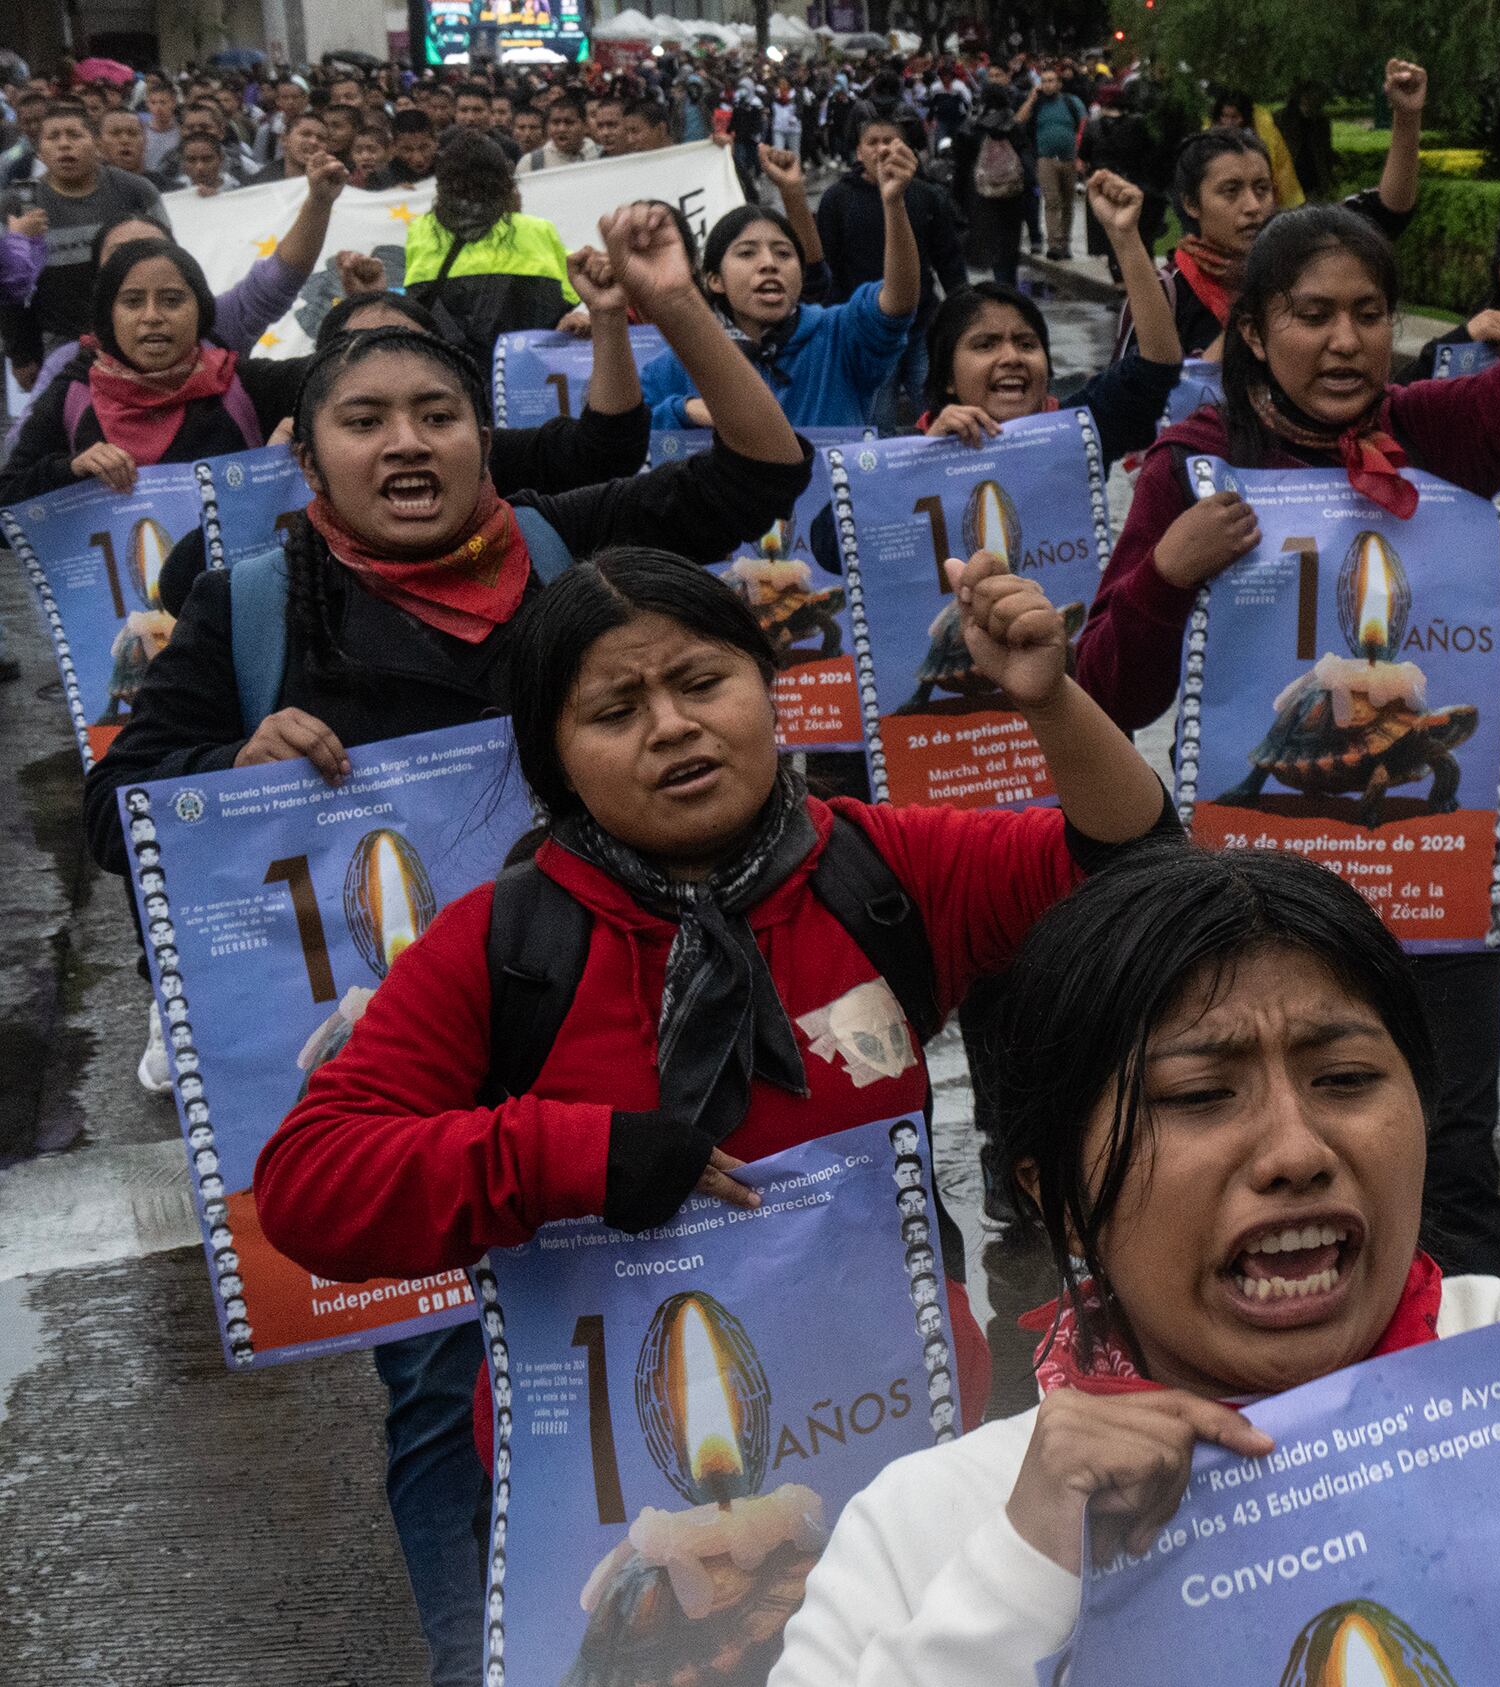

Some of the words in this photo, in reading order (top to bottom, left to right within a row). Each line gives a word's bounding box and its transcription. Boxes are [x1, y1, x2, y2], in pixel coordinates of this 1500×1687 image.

[1323, 508, 1382, 520] Convocan
[1021, 538, 1089, 571] AÑOS
[1403, 618, 1493, 652] AÑOS
[799, 672, 816, 685] de
[818, 671, 852, 684] 2024
[788, 720, 799, 732] al
[804, 718, 843, 731] Zócalo
[809, 704, 824, 716] de
[907, 735, 928, 749] 26
[932, 730, 951, 745] de
[972, 741, 1007, 757] 16:00
[219, 788, 260, 802] Escuela
[261, 781, 300, 795] Normal
[353, 766, 379, 778] Isidro
[416, 752, 428, 765] de
[928, 764, 980, 782] Marcha
[986, 757, 1007, 773] del
[1013, 752, 1047, 769] Ánge
[222, 804, 261, 818] Madres
[263, 803, 270, 813] y
[272, 796, 307, 810] Padres
[308, 791, 321, 802] de
[322, 789, 335, 801] los
[337, 785, 349, 796] 43
[352, 776, 404, 794] Estudiantes
[928, 774, 1028, 799] Independencia
[1034, 769, 1047, 783] al
[995, 787, 1034, 803] CDMX
[317, 801, 393, 826] Convocan
[1223, 832, 1249, 849] 26
[1254, 832, 1277, 849] de
[1284, 834, 1386, 857] septiembre
[1392, 834, 1414, 851] de
[1421, 835, 1466, 851] 2024
[1347, 861, 1393, 875] Horas
[1402, 881, 1421, 898] de
[1428, 880, 1444, 898] la
[1391, 903, 1445, 920] Zócalo
[769, 1164, 844, 1193] Ayotzinapa,
[845, 1154, 873, 1169] Gro.
[540, 1236, 569, 1250] Madres
[570, 1238, 576, 1250] y
[577, 1234, 607, 1247] Padres
[609, 1232, 621, 1243] de
[621, 1230, 634, 1243] los
[637, 1229, 651, 1241] 43
[654, 1214, 725, 1241] Estudiantes
[729, 1191, 835, 1224] Desaparecidos.
[615, 1253, 704, 1278] Convocan
[311, 1267, 466, 1316] Independencia
[418, 1284, 475, 1314] CDMX
[772, 1378, 912, 1470] AÑOS
[1267, 1439, 1329, 1476] Isidro
[1333, 1404, 1414, 1452] Burgos"
[1423, 1397, 1453, 1422] de
[1158, 1526, 1187, 1554] de
[1191, 1514, 1227, 1538] los
[1232, 1503, 1262, 1527] 43
[1267, 1459, 1394, 1517] Estudiantes
[1181, 1528, 1368, 1608] Convocan
